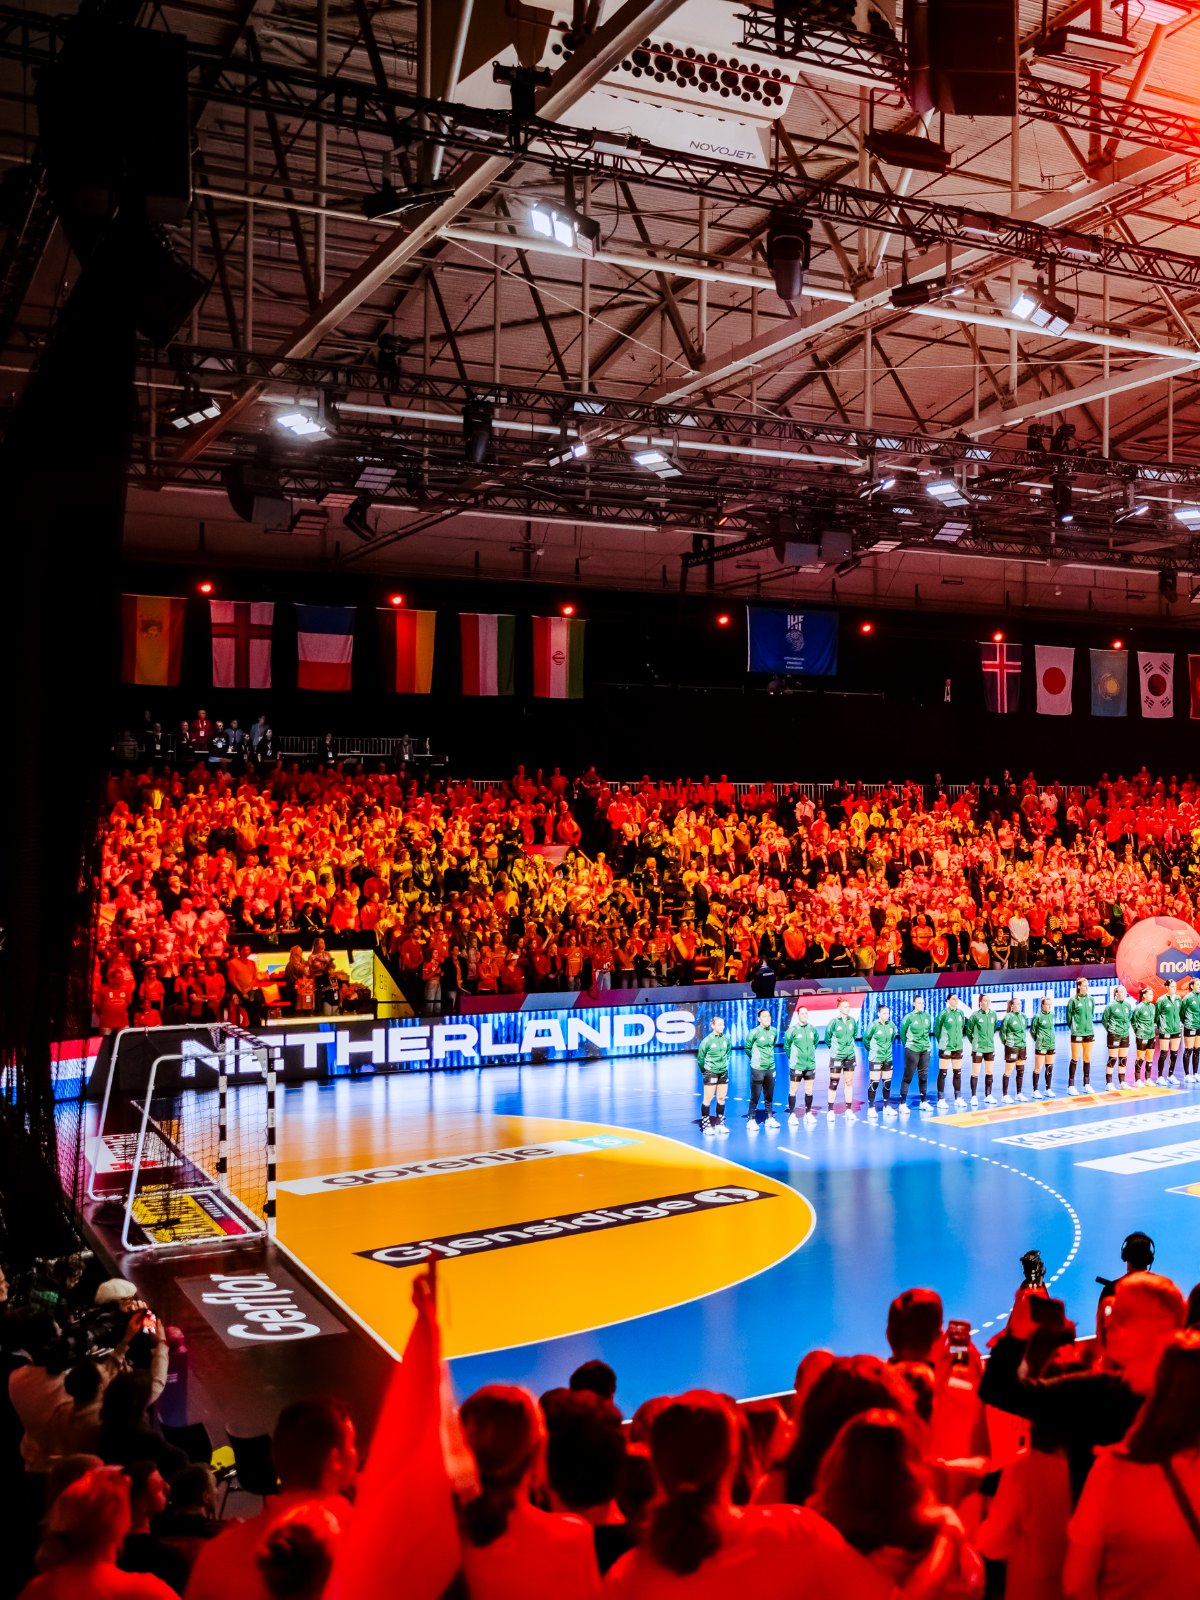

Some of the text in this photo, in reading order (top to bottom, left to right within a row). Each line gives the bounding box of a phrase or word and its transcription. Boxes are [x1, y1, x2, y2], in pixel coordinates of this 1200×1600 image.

[690, 140, 753, 159] NOVOJET
[181, 1010, 696, 1078] NETHERLANDS
[321, 1147, 555, 1188] gorenje
[371, 1200, 698, 1263] Gjensidige
